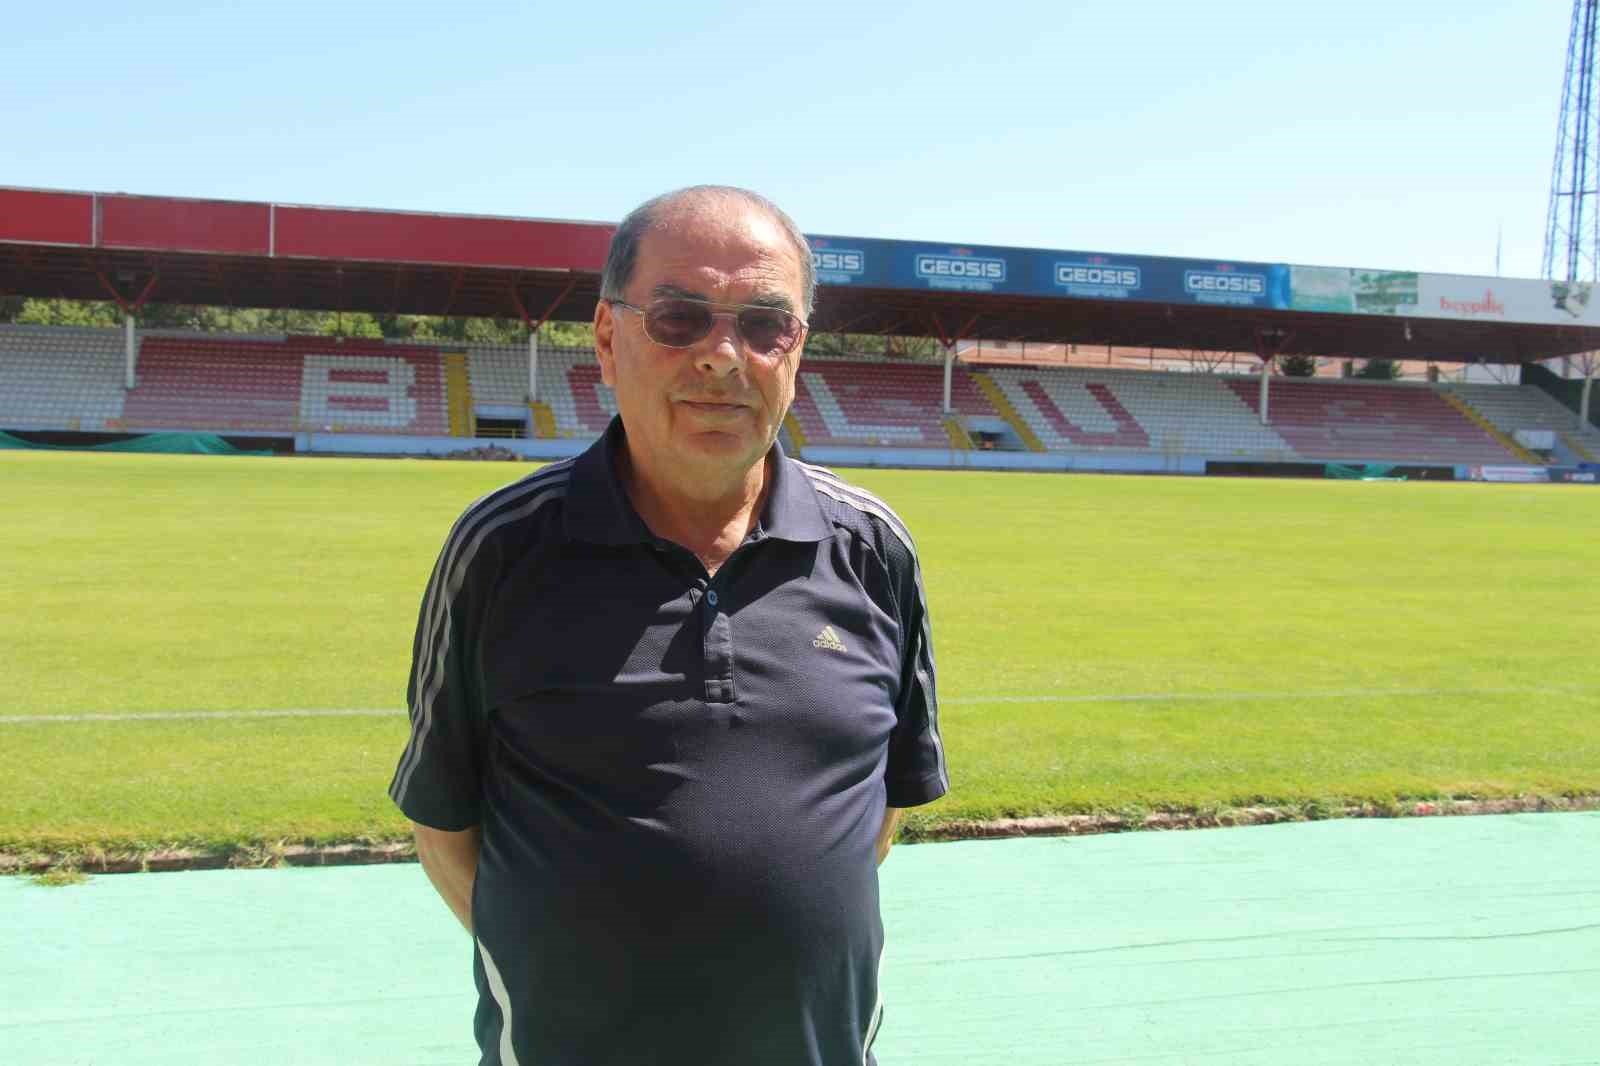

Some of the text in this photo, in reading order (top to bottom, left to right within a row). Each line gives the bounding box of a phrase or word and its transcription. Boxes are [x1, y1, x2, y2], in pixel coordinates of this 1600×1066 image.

[919, 258, 1002, 277] GEOSIS
[1058, 267, 1137, 285] GEOSIS
[1188, 275, 1262, 292] GEOSIS
[812, 639, 848, 653] adidas
